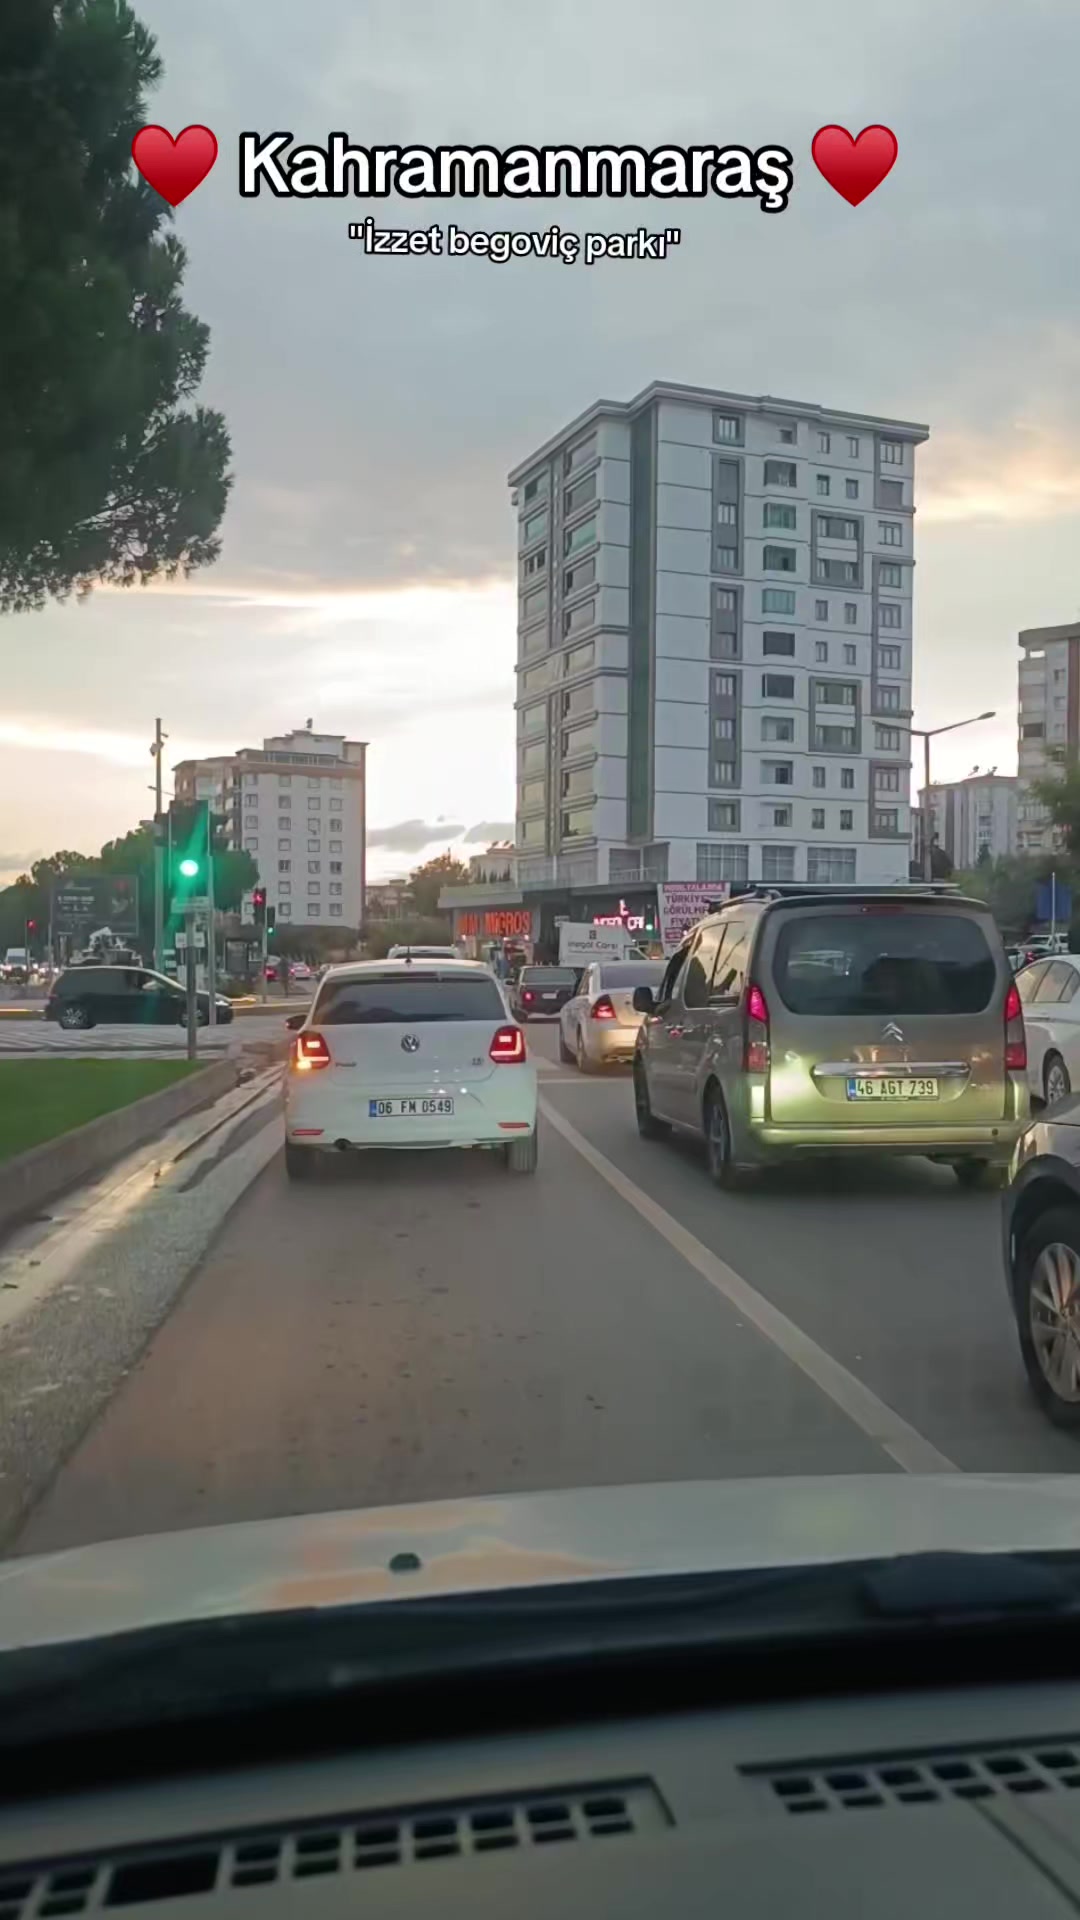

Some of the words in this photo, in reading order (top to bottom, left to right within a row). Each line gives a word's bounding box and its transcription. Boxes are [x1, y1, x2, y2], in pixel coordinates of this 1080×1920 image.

[857, 1080, 873, 1095] 46
[880, 1080, 904, 1095] AGT
[910, 1080, 934, 1095] 739
[378, 1102, 393, 1114] 06
[400, 1101, 417, 1113] FM
[422, 1099, 452, 1113] 0549
